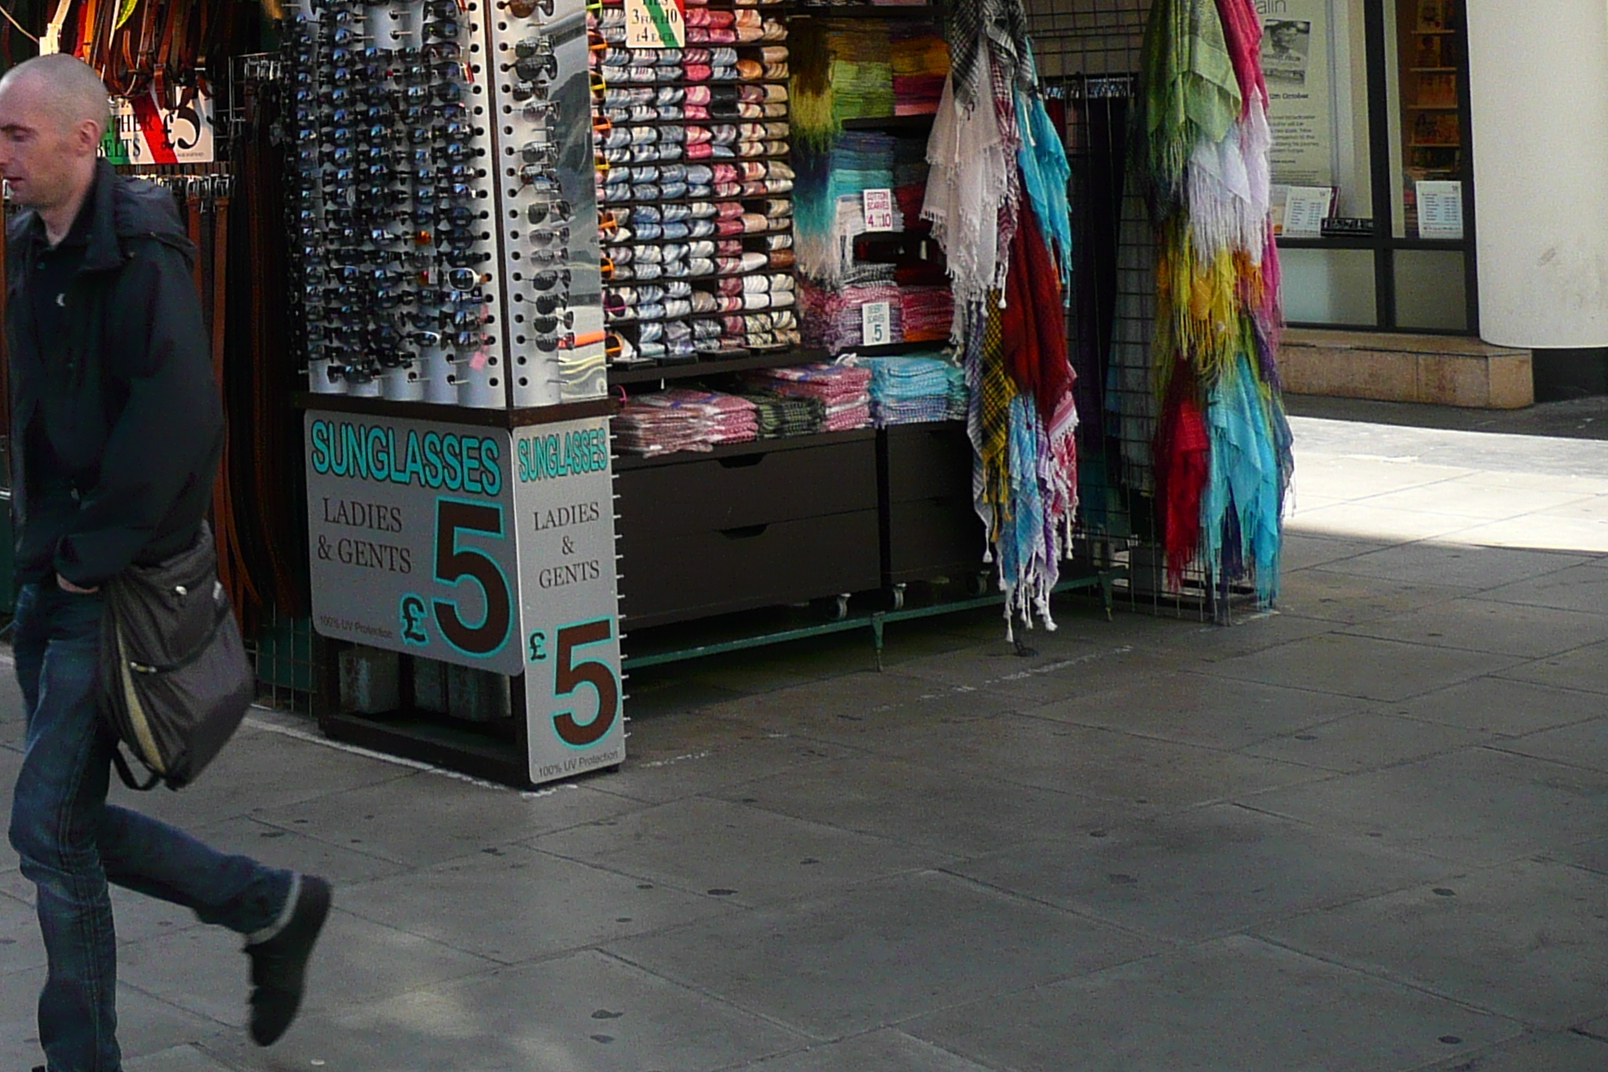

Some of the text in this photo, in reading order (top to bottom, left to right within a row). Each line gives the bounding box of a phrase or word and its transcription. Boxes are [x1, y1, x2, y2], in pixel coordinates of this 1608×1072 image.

[631, 8, 639, 24] 3
[641, 15, 657, 24] FOR
[96, 138, 141, 158] BELTS
[311, 419, 503, 496] SUNGLASSES
[517, 428, 608, 483] SUNGLASSES
[323, 498, 403, 533] LADIES
[533, 502, 600, 532] LADIES
[317, 534, 412, 574] & GENTS
[561, 535, 574, 556] &
[539, 559, 600, 589] GENTS
[319, 615, 341, 629] 100%
[341, 618, 353, 631] UV
[539, 750, 619, 777] 100% UV Protection
